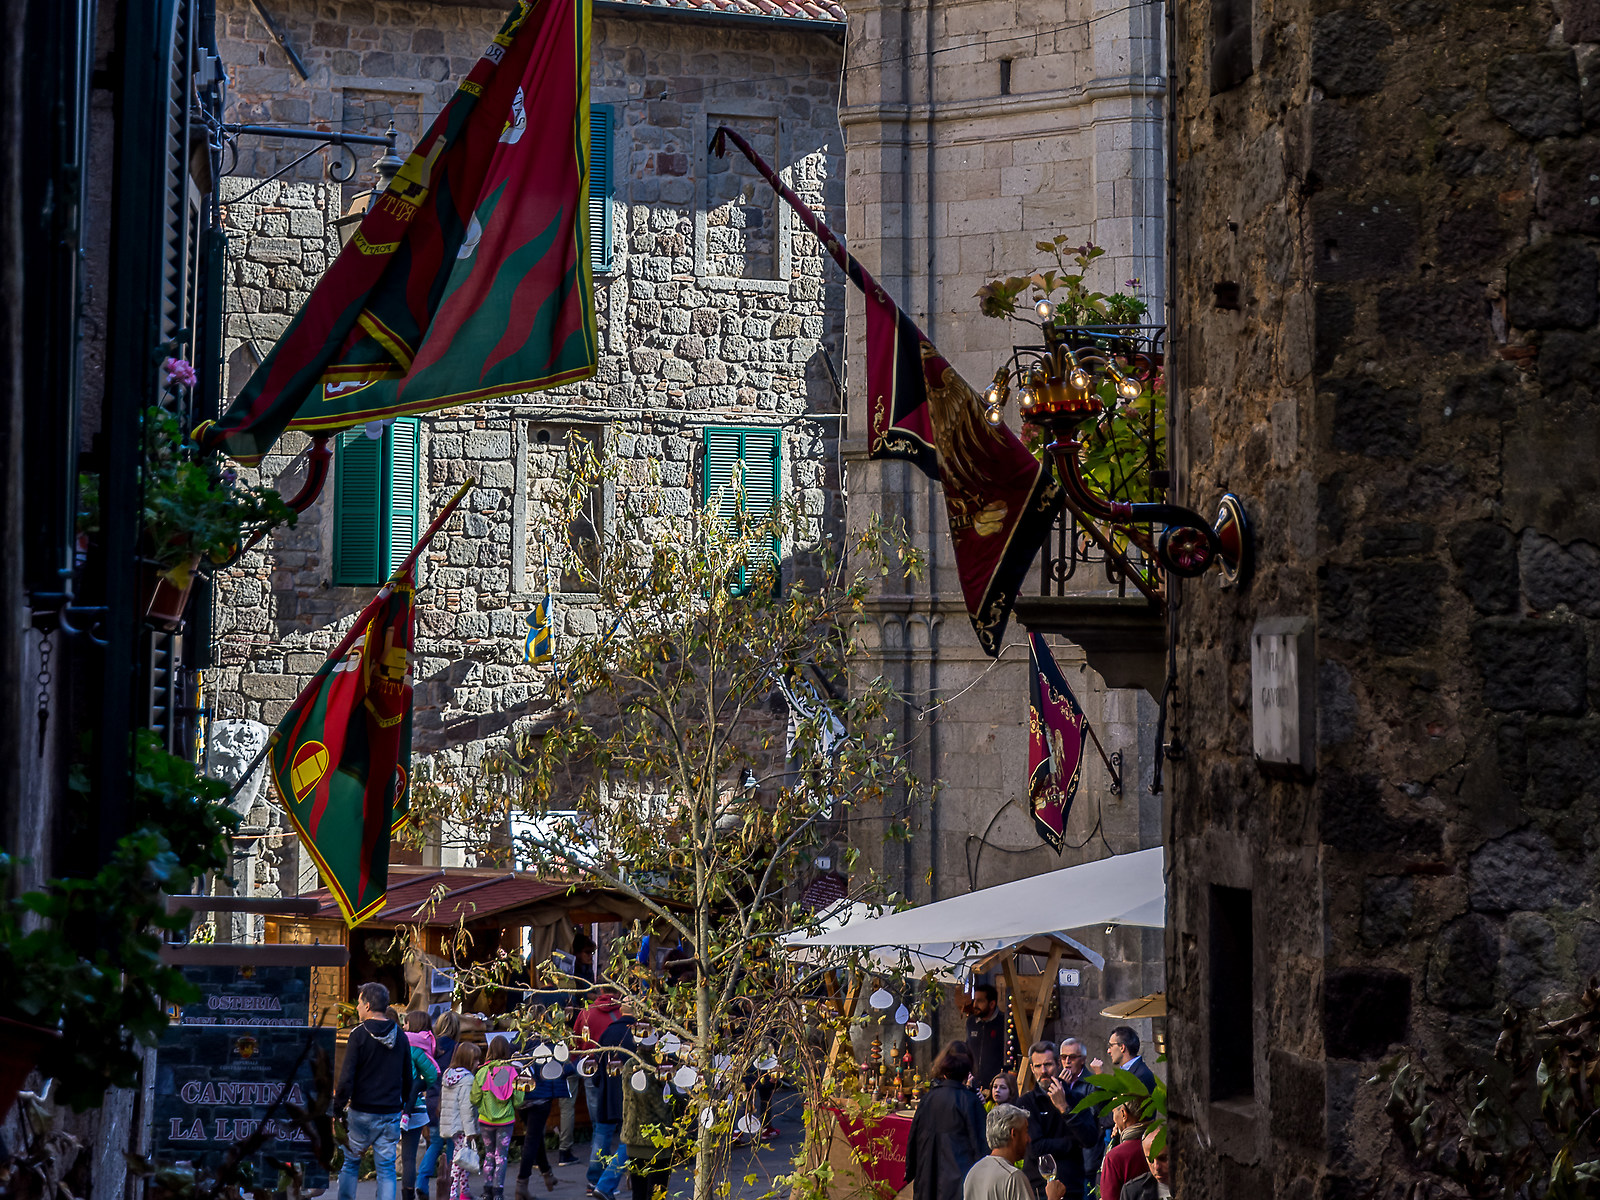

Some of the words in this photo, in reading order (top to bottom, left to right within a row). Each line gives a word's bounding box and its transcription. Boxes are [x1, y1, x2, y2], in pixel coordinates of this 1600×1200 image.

[207, 996, 282, 1011] OSTERIA
[180, 1081, 305, 1105] CANTINA
[168, 1117, 207, 1140] LA
